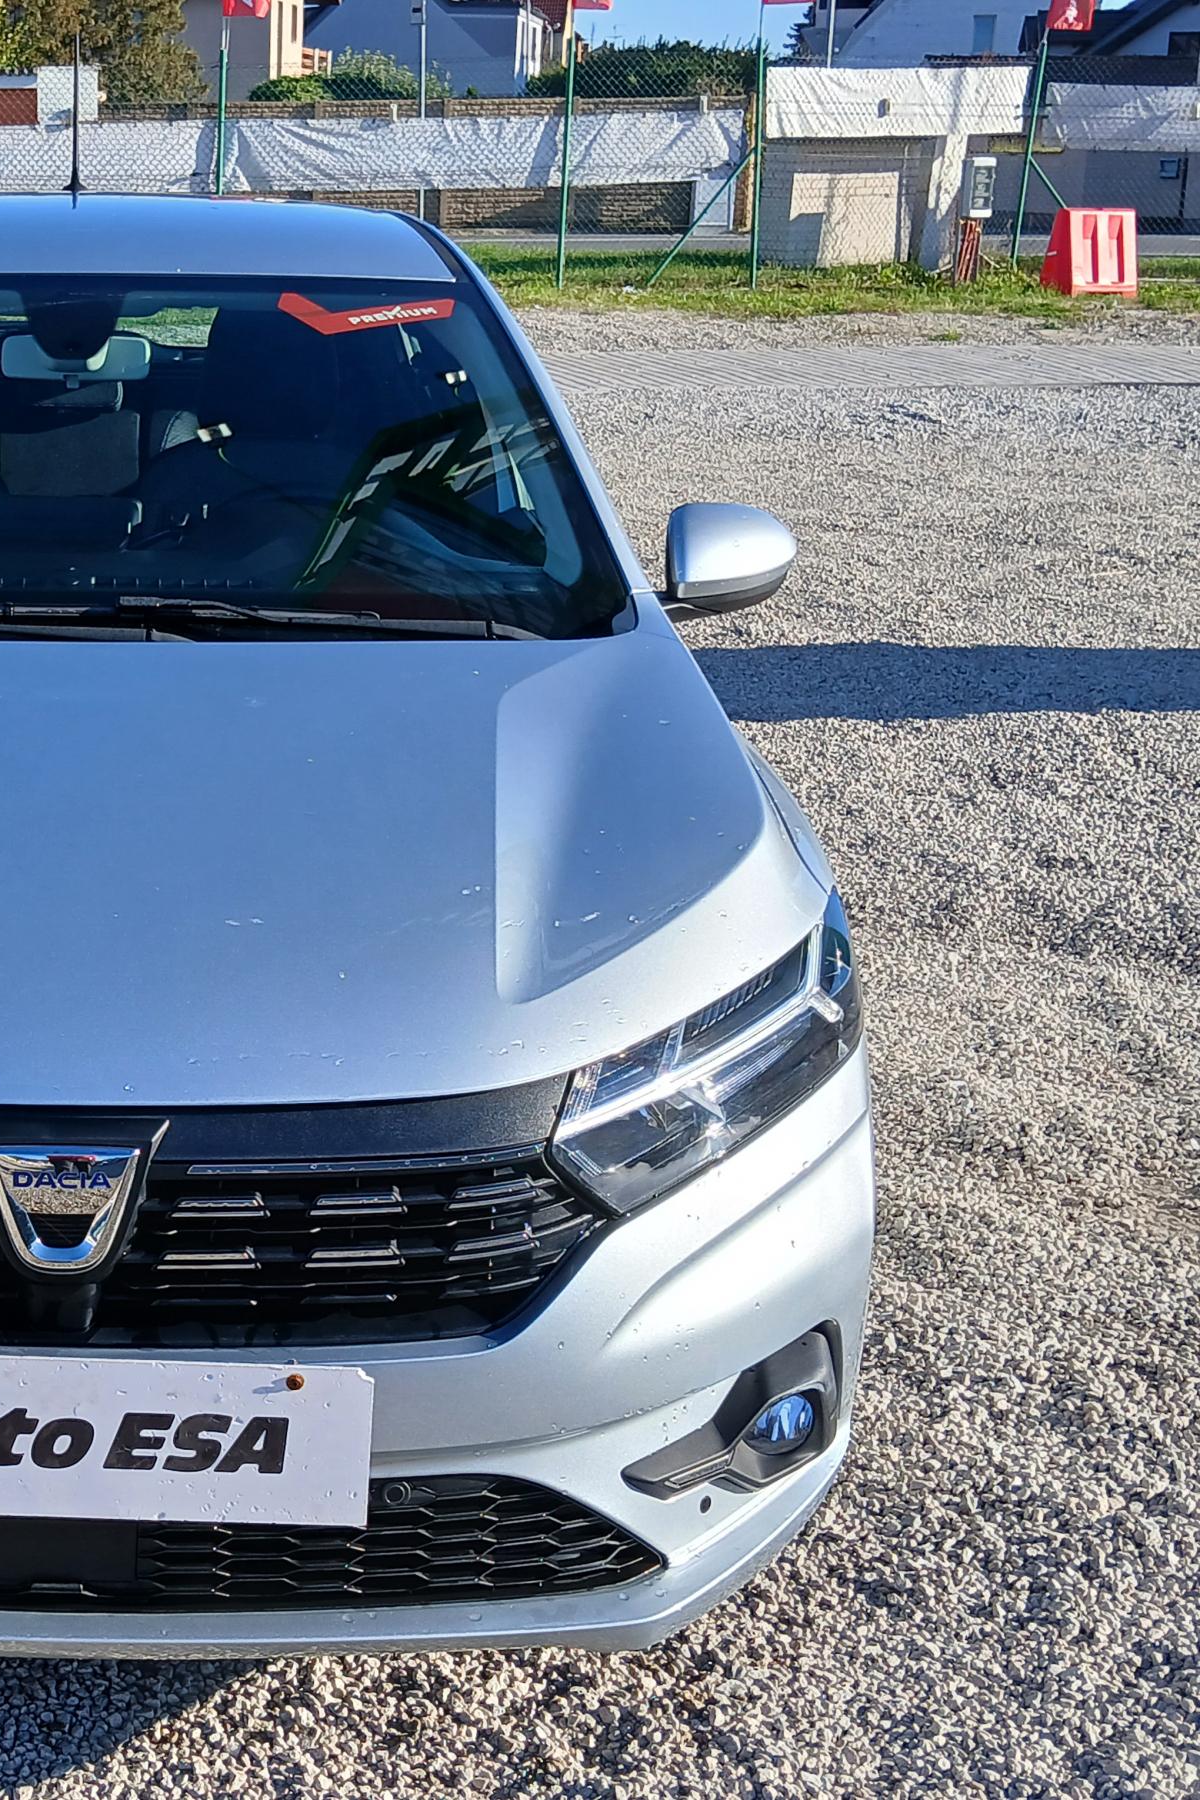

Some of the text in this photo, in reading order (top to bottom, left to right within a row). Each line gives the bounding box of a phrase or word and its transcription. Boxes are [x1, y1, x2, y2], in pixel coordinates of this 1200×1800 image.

[347, 305, 437, 325] PREMIUM
[12, 1172, 111, 1189] DACIA
[102, 1412, 290, 1474] ESA
